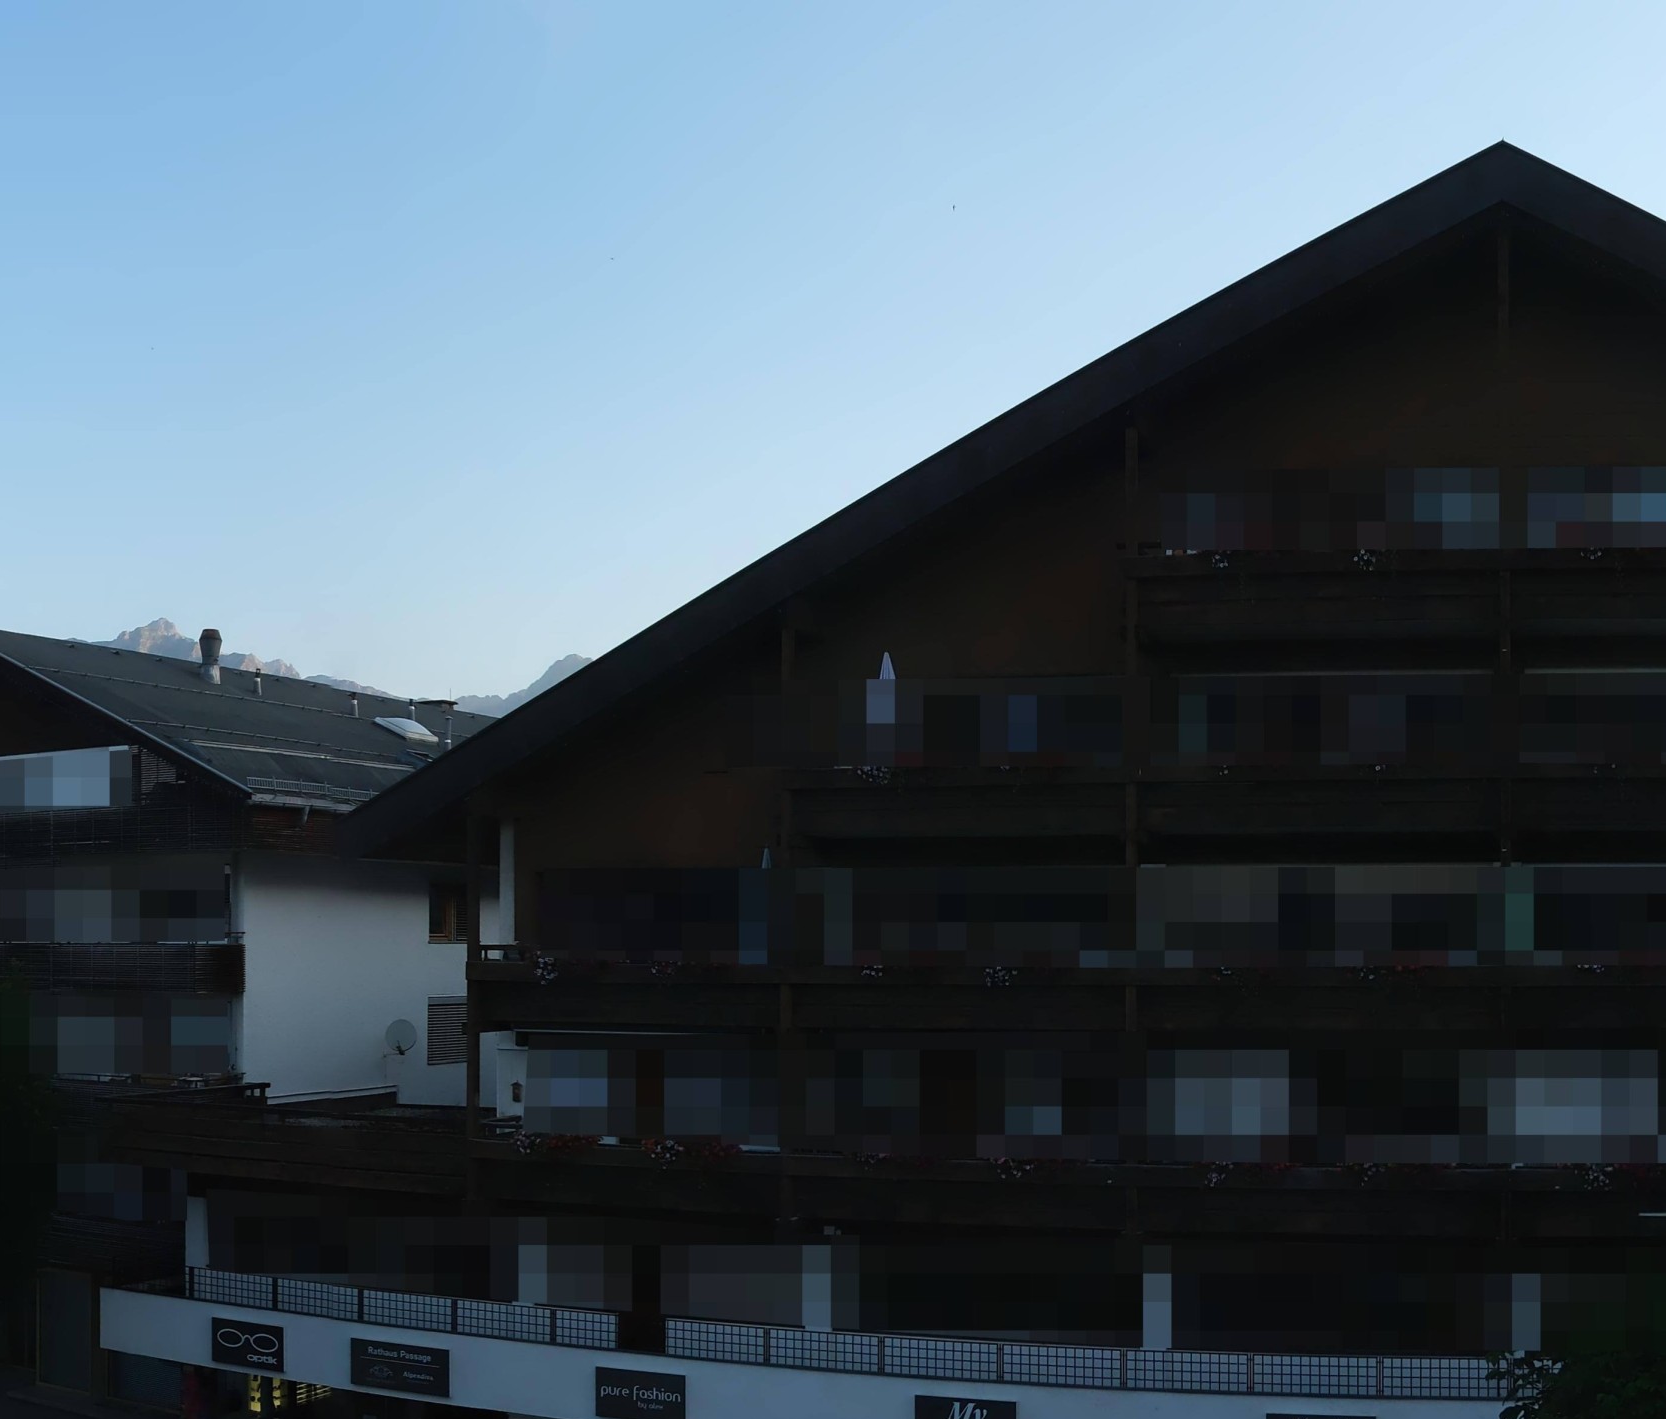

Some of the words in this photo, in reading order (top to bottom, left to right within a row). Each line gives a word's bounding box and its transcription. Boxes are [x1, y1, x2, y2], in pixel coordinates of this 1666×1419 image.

[367, 1346, 398, 1358] Rathaus
[400, 1350, 432, 1363] Passage
[600, 1385, 629, 1398] pure
[633, 1385, 681, 1402] fashion
